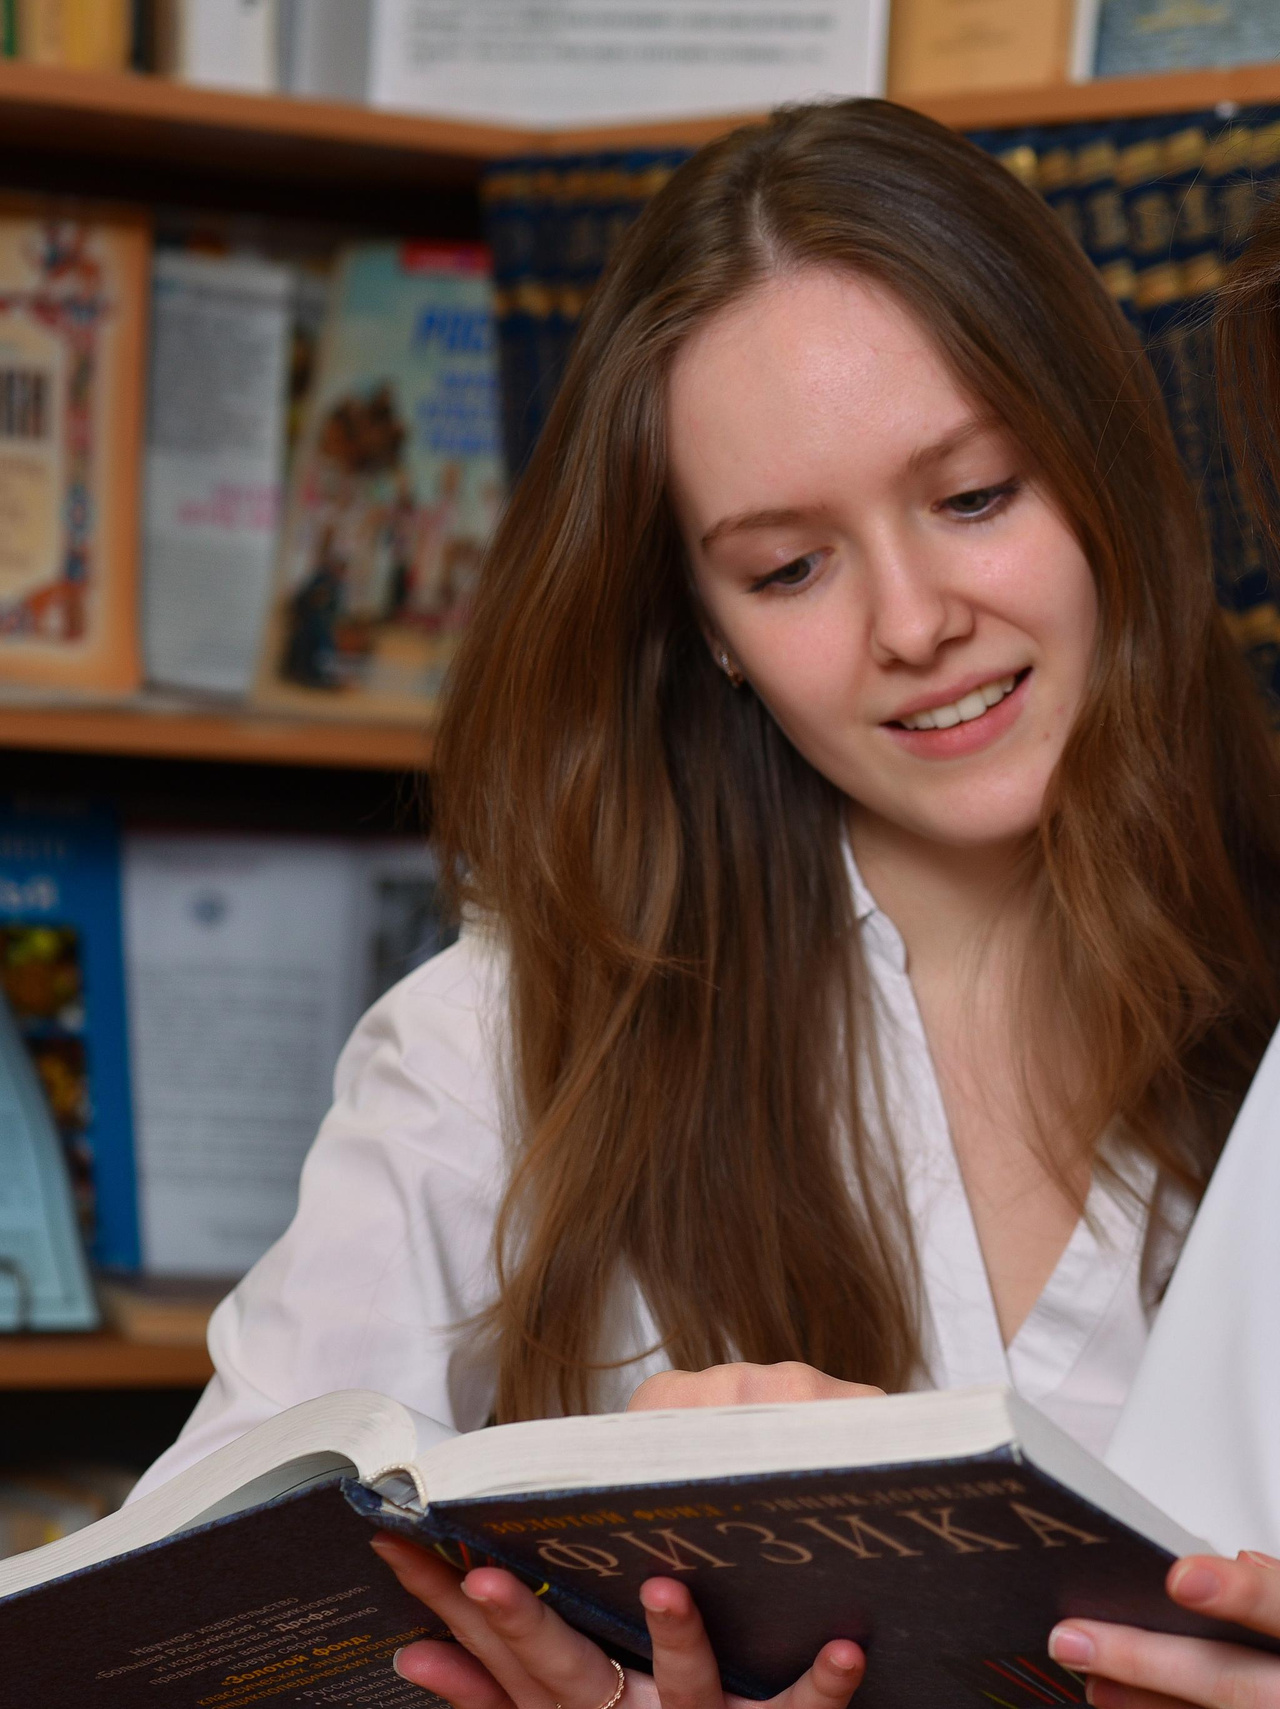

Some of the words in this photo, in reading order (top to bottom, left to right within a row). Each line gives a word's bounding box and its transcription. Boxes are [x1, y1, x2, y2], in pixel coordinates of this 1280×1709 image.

[535, 1500, 1110, 1578] ФИЗИКА
[632, 1503, 726, 1522] ФОНД
[95, 1653, 167, 1680] «Большая
[164, 1623, 256, 1656] Российская
[256, 1585, 371, 1626] энциклопедия»
[128, 1631, 196, 1657] Научное
[196, 1597, 299, 1635] издательство
[148, 1653, 237, 1686] предлагают
[238, 1632, 300, 1656] вашему
[299, 1606, 379, 1636] вниманию
[153, 1665, 168, 1673] и
[167, 1631, 269, 1668] издательство
[270, 1607, 340, 1633] «Дрофа»
[228, 1652, 277, 1672] новую
[277, 1635, 328, 1655] серию
[196, 1666, 310, 1707] классических
[308, 1625, 431, 1670] энциклопедий
[221, 1653, 310, 1687] «Золотой
[311, 1633, 372, 1657] фонд»
[302, 1673, 368, 1698] Русский
[322, 1675, 401, 1703] Математи
[355, 1682, 415, 1703] Физика
[372, 1689, 426, 1709] Химия
